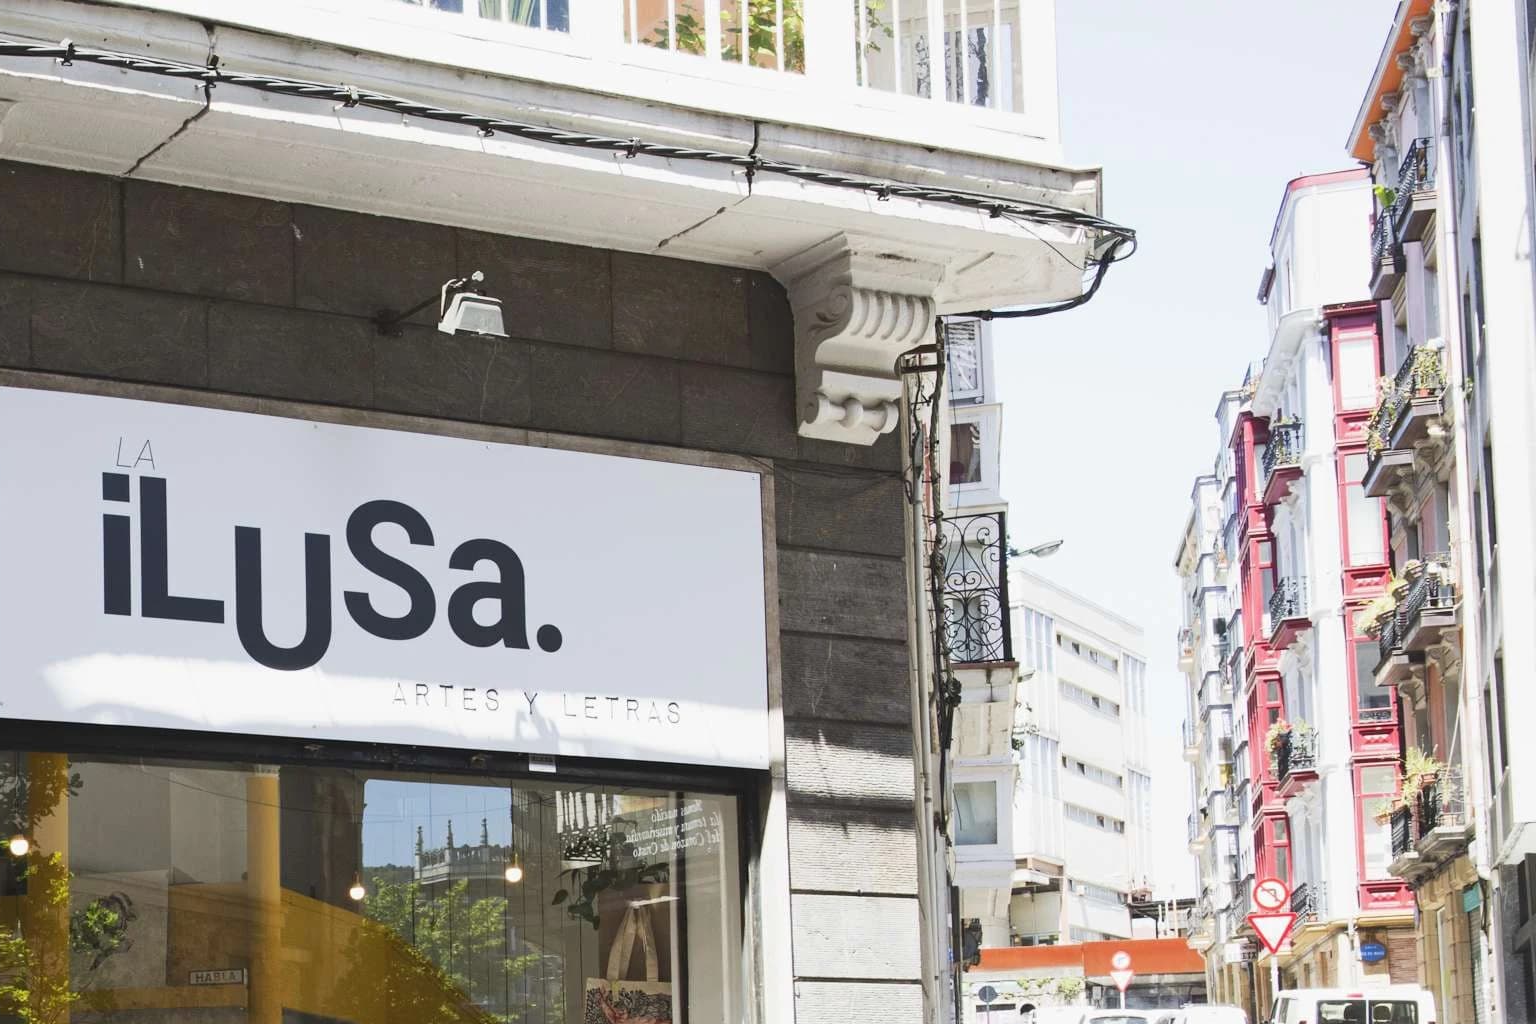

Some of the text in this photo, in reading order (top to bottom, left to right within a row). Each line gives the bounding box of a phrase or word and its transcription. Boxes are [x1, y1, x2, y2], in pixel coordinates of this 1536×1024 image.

[116, 436, 156, 470] LA
[391, 682, 681, 724] ARTES Y LETRAS
